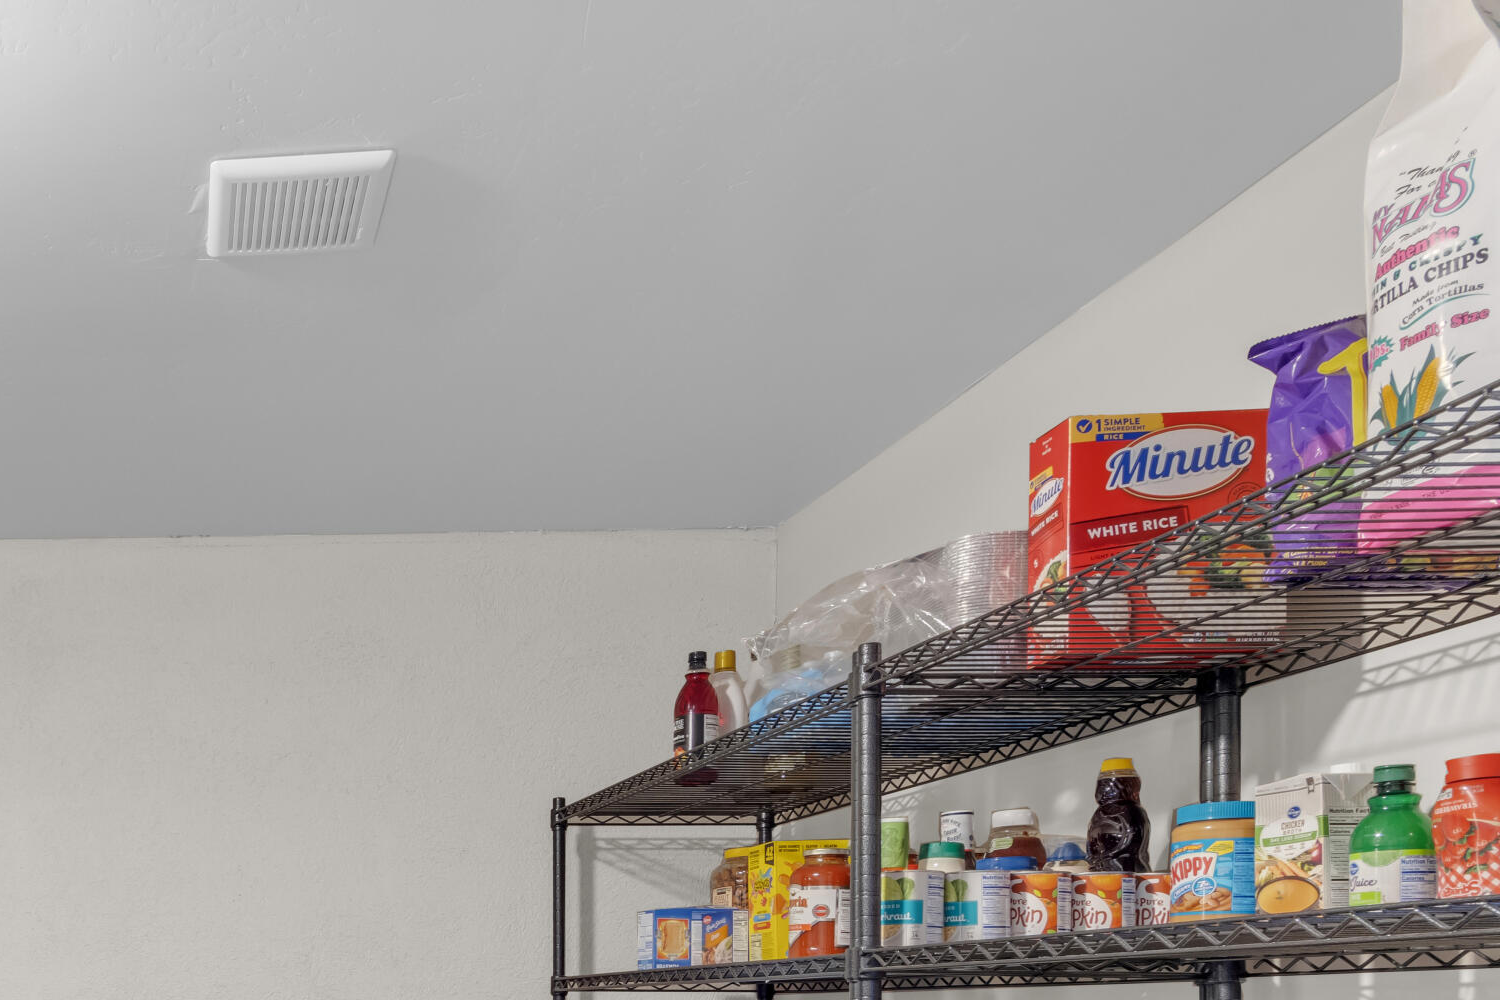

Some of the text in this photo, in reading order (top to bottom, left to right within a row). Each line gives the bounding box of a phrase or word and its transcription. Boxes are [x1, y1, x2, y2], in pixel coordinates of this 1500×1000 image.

[1423, 247, 1490, 283] CHIPS
[1401, 281, 1485, 326] Corn Tortillas
[1450, 308, 1491, 329] Size
[1103, 417, 1141, 426] SIMPLE
[1103, 424, 1146, 432] INGREDIENT
[1103, 433, 1125, 441] RICE
[1108, 433, 1254, 488] Minute
[1032, 477, 1065, 514] Minute
[1030, 509, 1059, 537] WHITE RICE
[1087, 515, 1179, 540] WHITE RICE
[1280, 819, 1306, 831] CHICKEN
[1350, 875, 1378, 892] Juice
